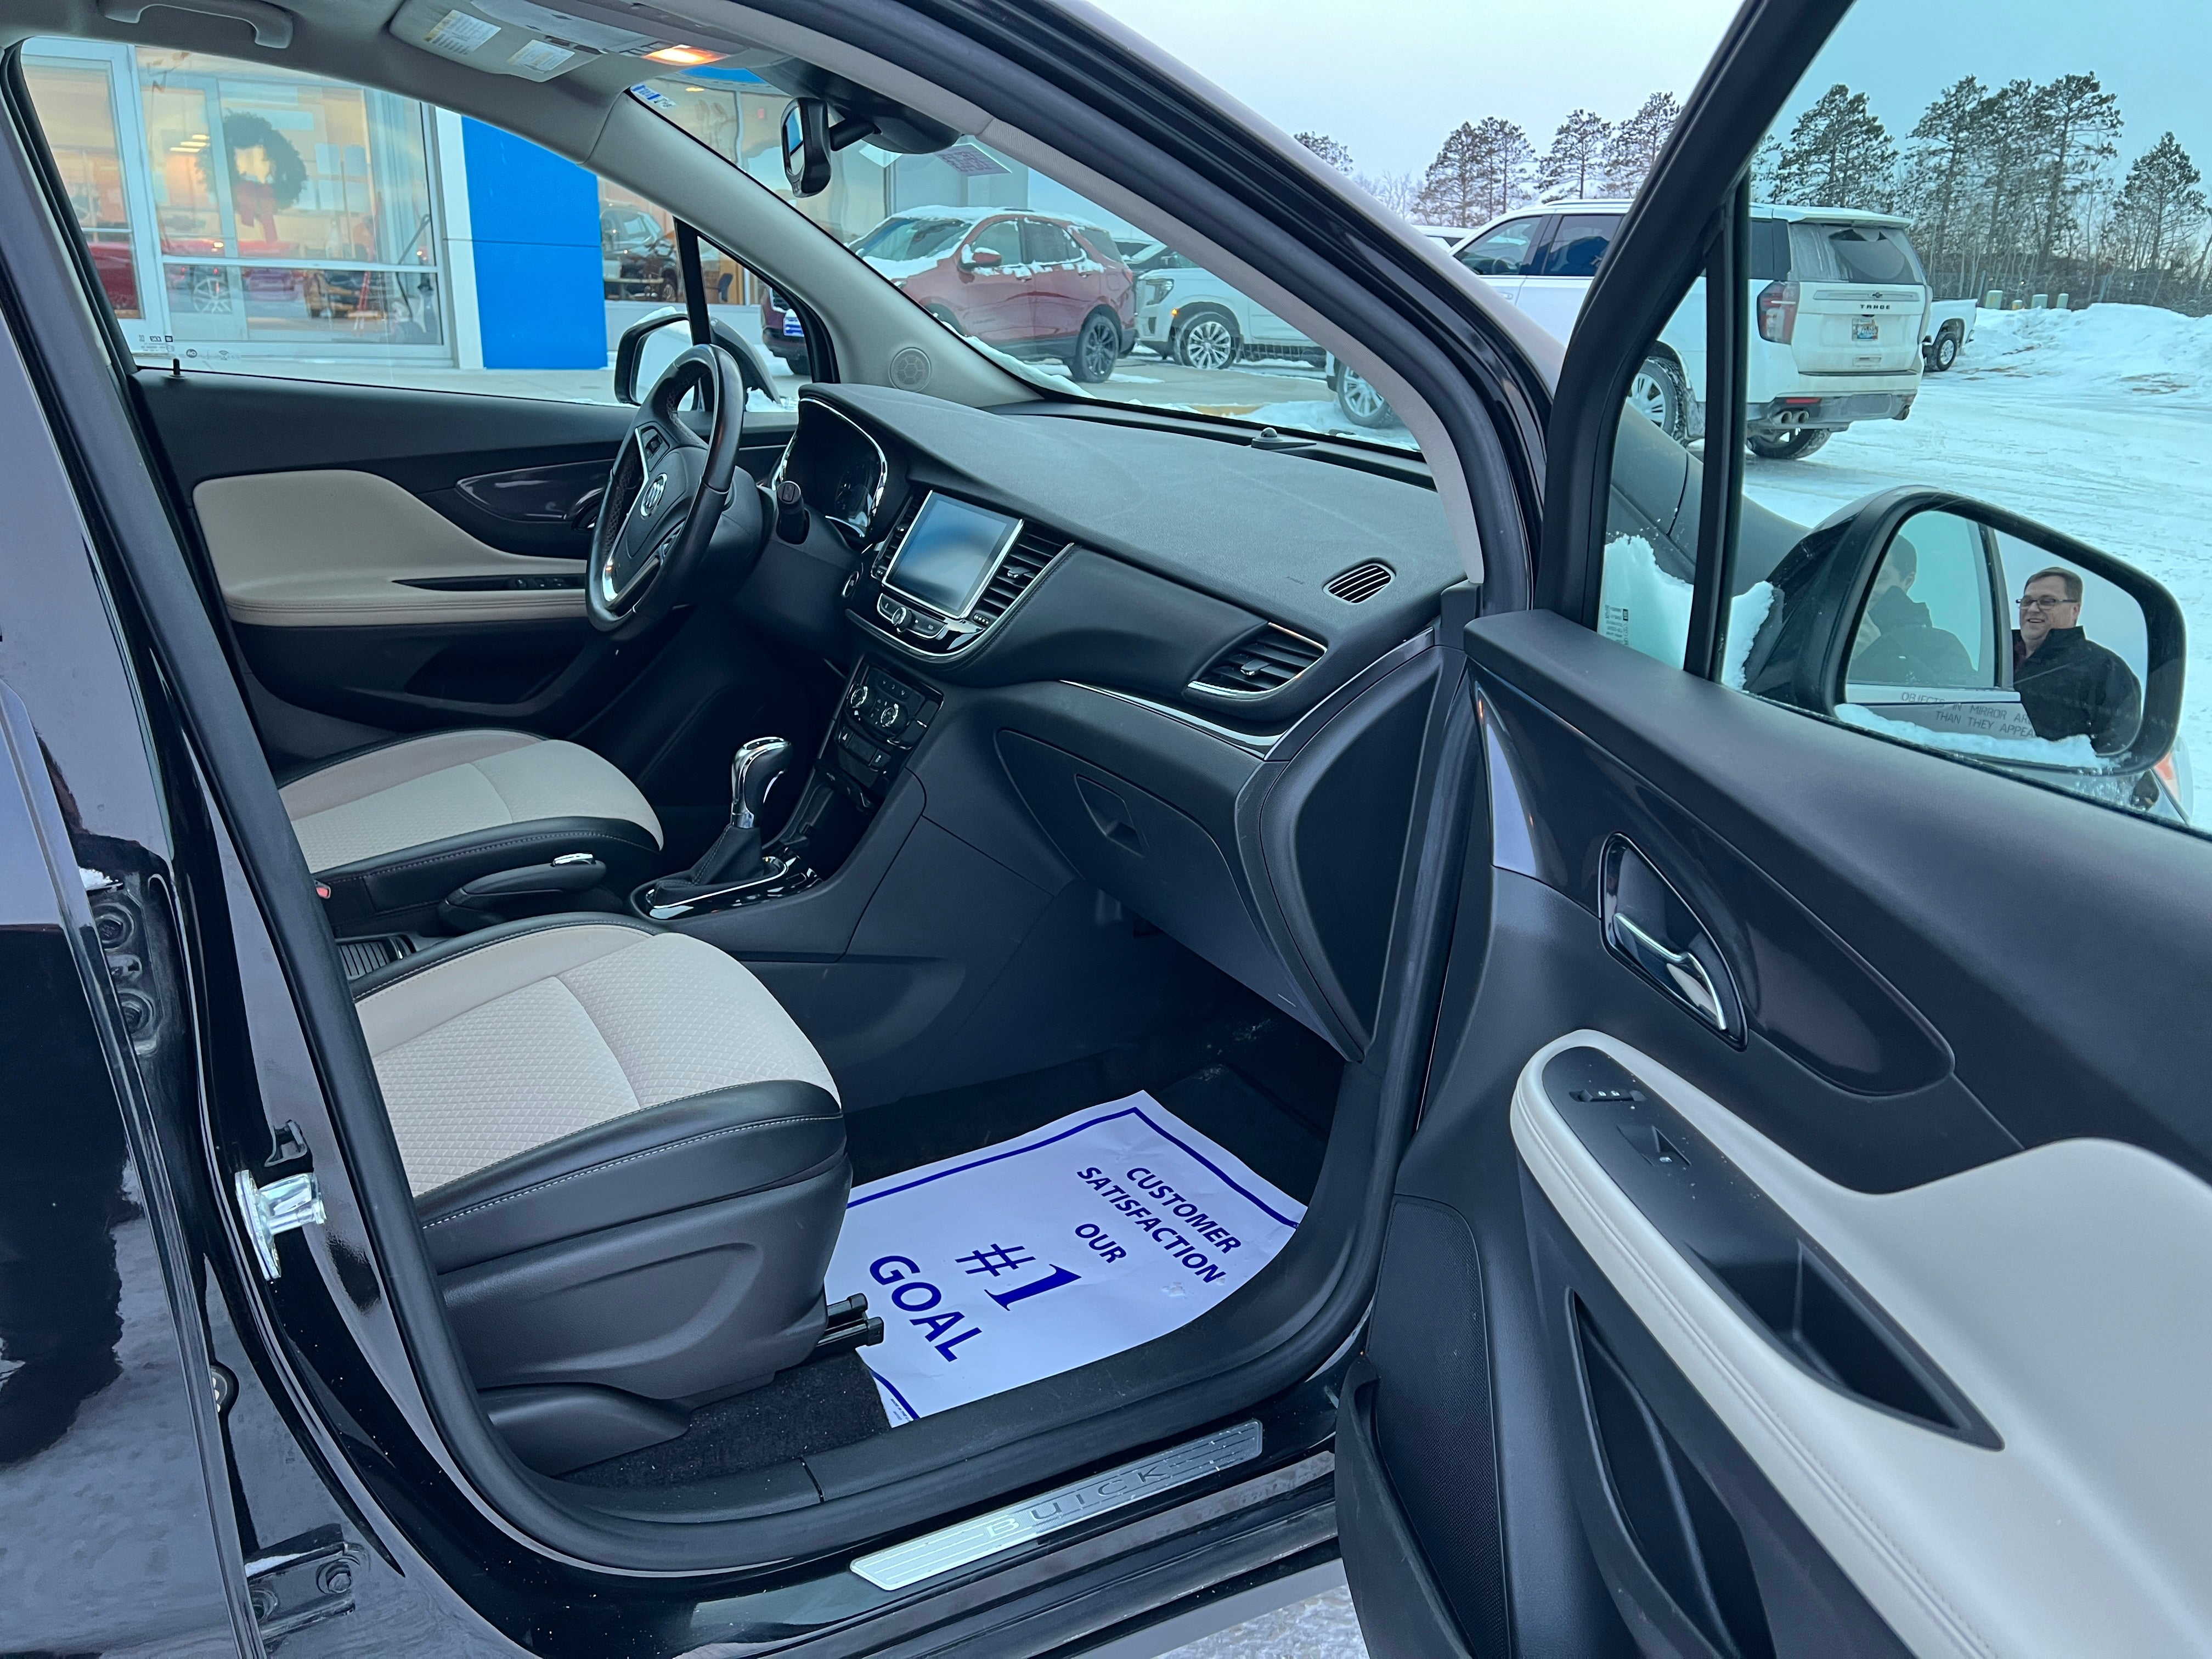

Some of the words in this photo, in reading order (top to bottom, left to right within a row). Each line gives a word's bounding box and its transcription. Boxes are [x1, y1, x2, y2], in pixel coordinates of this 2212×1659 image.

[1901, 692, 1945, 708] OBJECTS
[1953, 703, 1962, 712] IN
[1970, 704, 2007, 720] MIRROR
[1936, 710, 1961, 724] THAN
[1968, 716, 1995, 730] THEY
[1999, 723, 2036, 738] APPEA
[1075, 1223, 1127, 1263] OUR
[1076, 1167, 1227, 1283] SATISFACTION
[1126, 1167, 1242, 1254] CUSTOMER
[870, 1255, 983, 1362] GOAL
[955, 1243, 1082, 1311] #1
[986, 1465, 1170, 1538] BUICK
